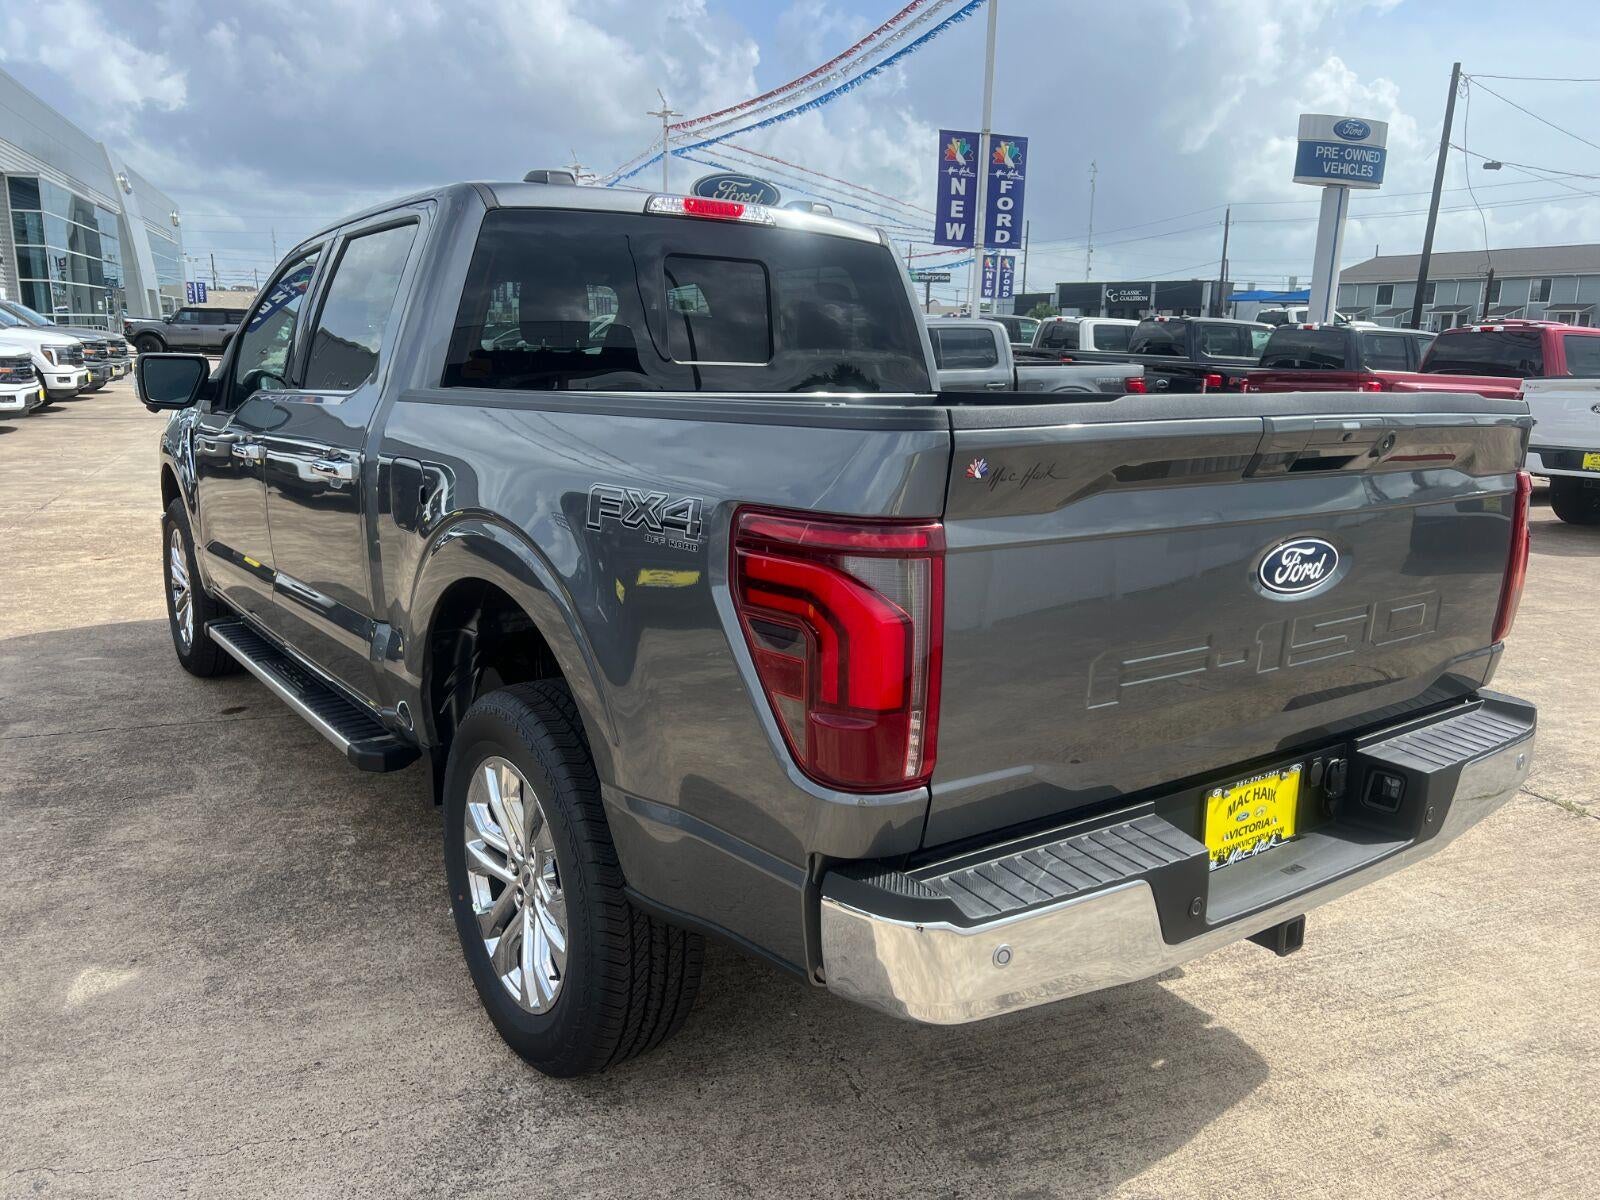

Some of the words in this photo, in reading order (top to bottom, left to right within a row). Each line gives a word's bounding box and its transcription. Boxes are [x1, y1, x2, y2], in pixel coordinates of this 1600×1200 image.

[1342, 122, 1364, 136] Ford
[1323, 161, 1373, 177] VEHICLES
[714, 180, 764, 204] Ford
[945, 177, 966, 241] NEW
[995, 180, 1014, 244] FORD
[984, 272, 993, 296] NEW
[1002, 273, 1010, 297] FORD
[586, 482, 703, 541] FX4
[644, 534, 666, 545] OFF
[669, 539, 699, 552] ROAD
[1274, 546, 1328, 584] Ford
[1086, 590, 1442, 709] F-150
[1227, 790, 1250, 819] MAC
[1253, 787, 1277, 803] HAIK
[1229, 818, 1270, 840] VICTORIA
